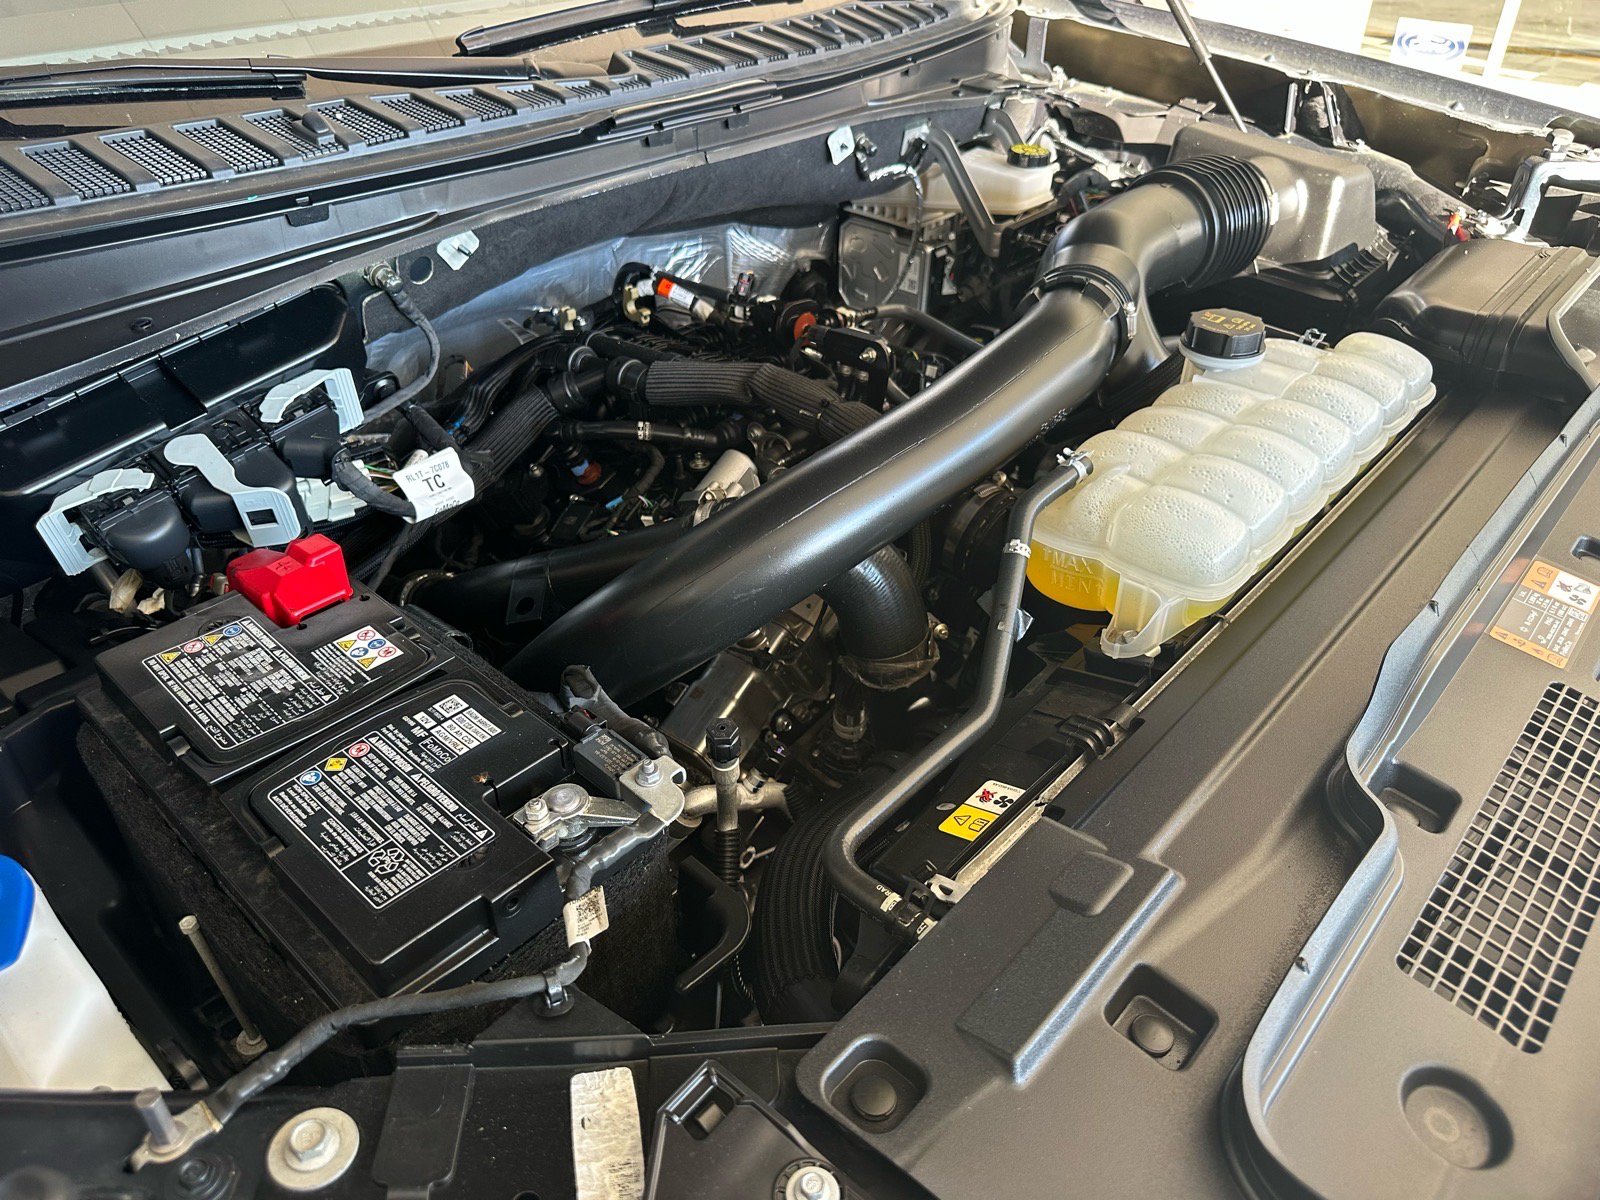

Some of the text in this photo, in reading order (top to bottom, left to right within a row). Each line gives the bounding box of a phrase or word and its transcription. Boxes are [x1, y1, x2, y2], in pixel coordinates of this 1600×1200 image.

[421, 473, 446, 492] TC
[1052, 551, 1094, 575] MAX
[1050, 569, 1092, 594] MIN
[418, 716, 432, 725] 12V
[409, 726, 429, 739] MF
[373, 739, 415, 773] DANGER/POISON
[422, 739, 454, 762] FoMoCo
[416, 777, 460, 813] PELIGRO/VENENO
